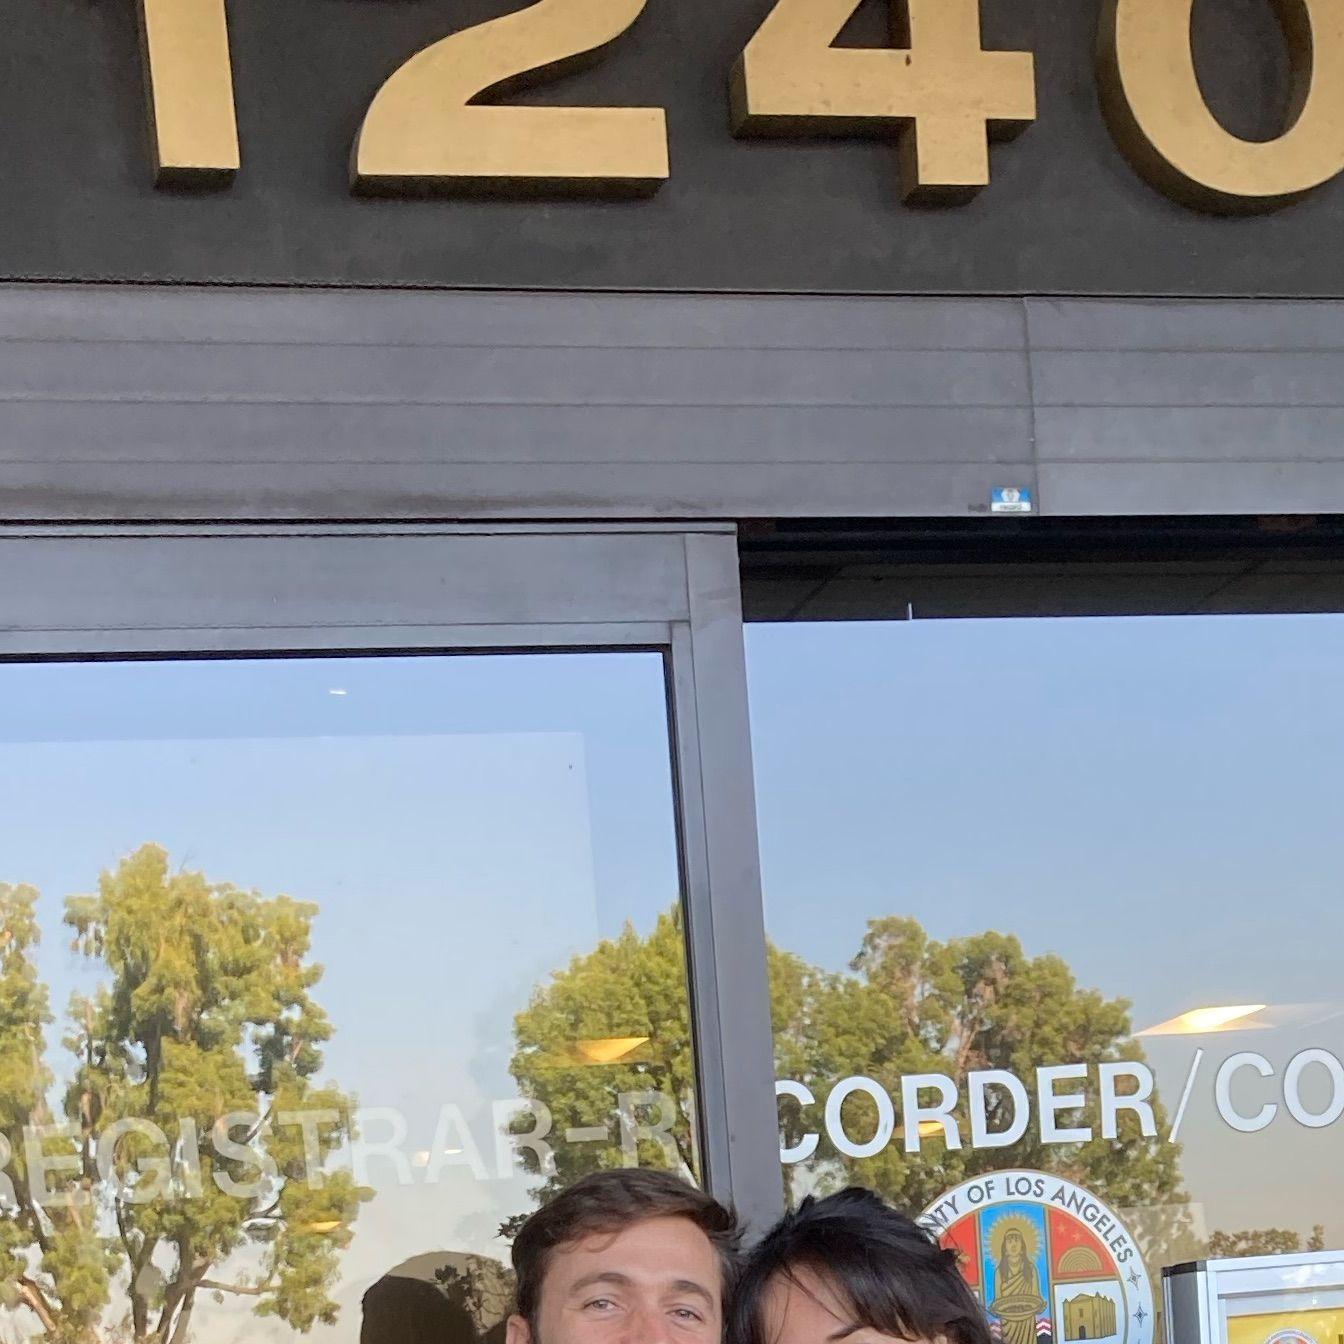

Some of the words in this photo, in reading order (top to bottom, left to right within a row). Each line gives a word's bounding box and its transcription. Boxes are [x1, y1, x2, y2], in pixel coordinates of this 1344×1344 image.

[967, 1180, 995, 1204] OF
[1006, 1177, 1046, 1198] LOS
[1050, 1185, 1134, 1263] ANGELES
